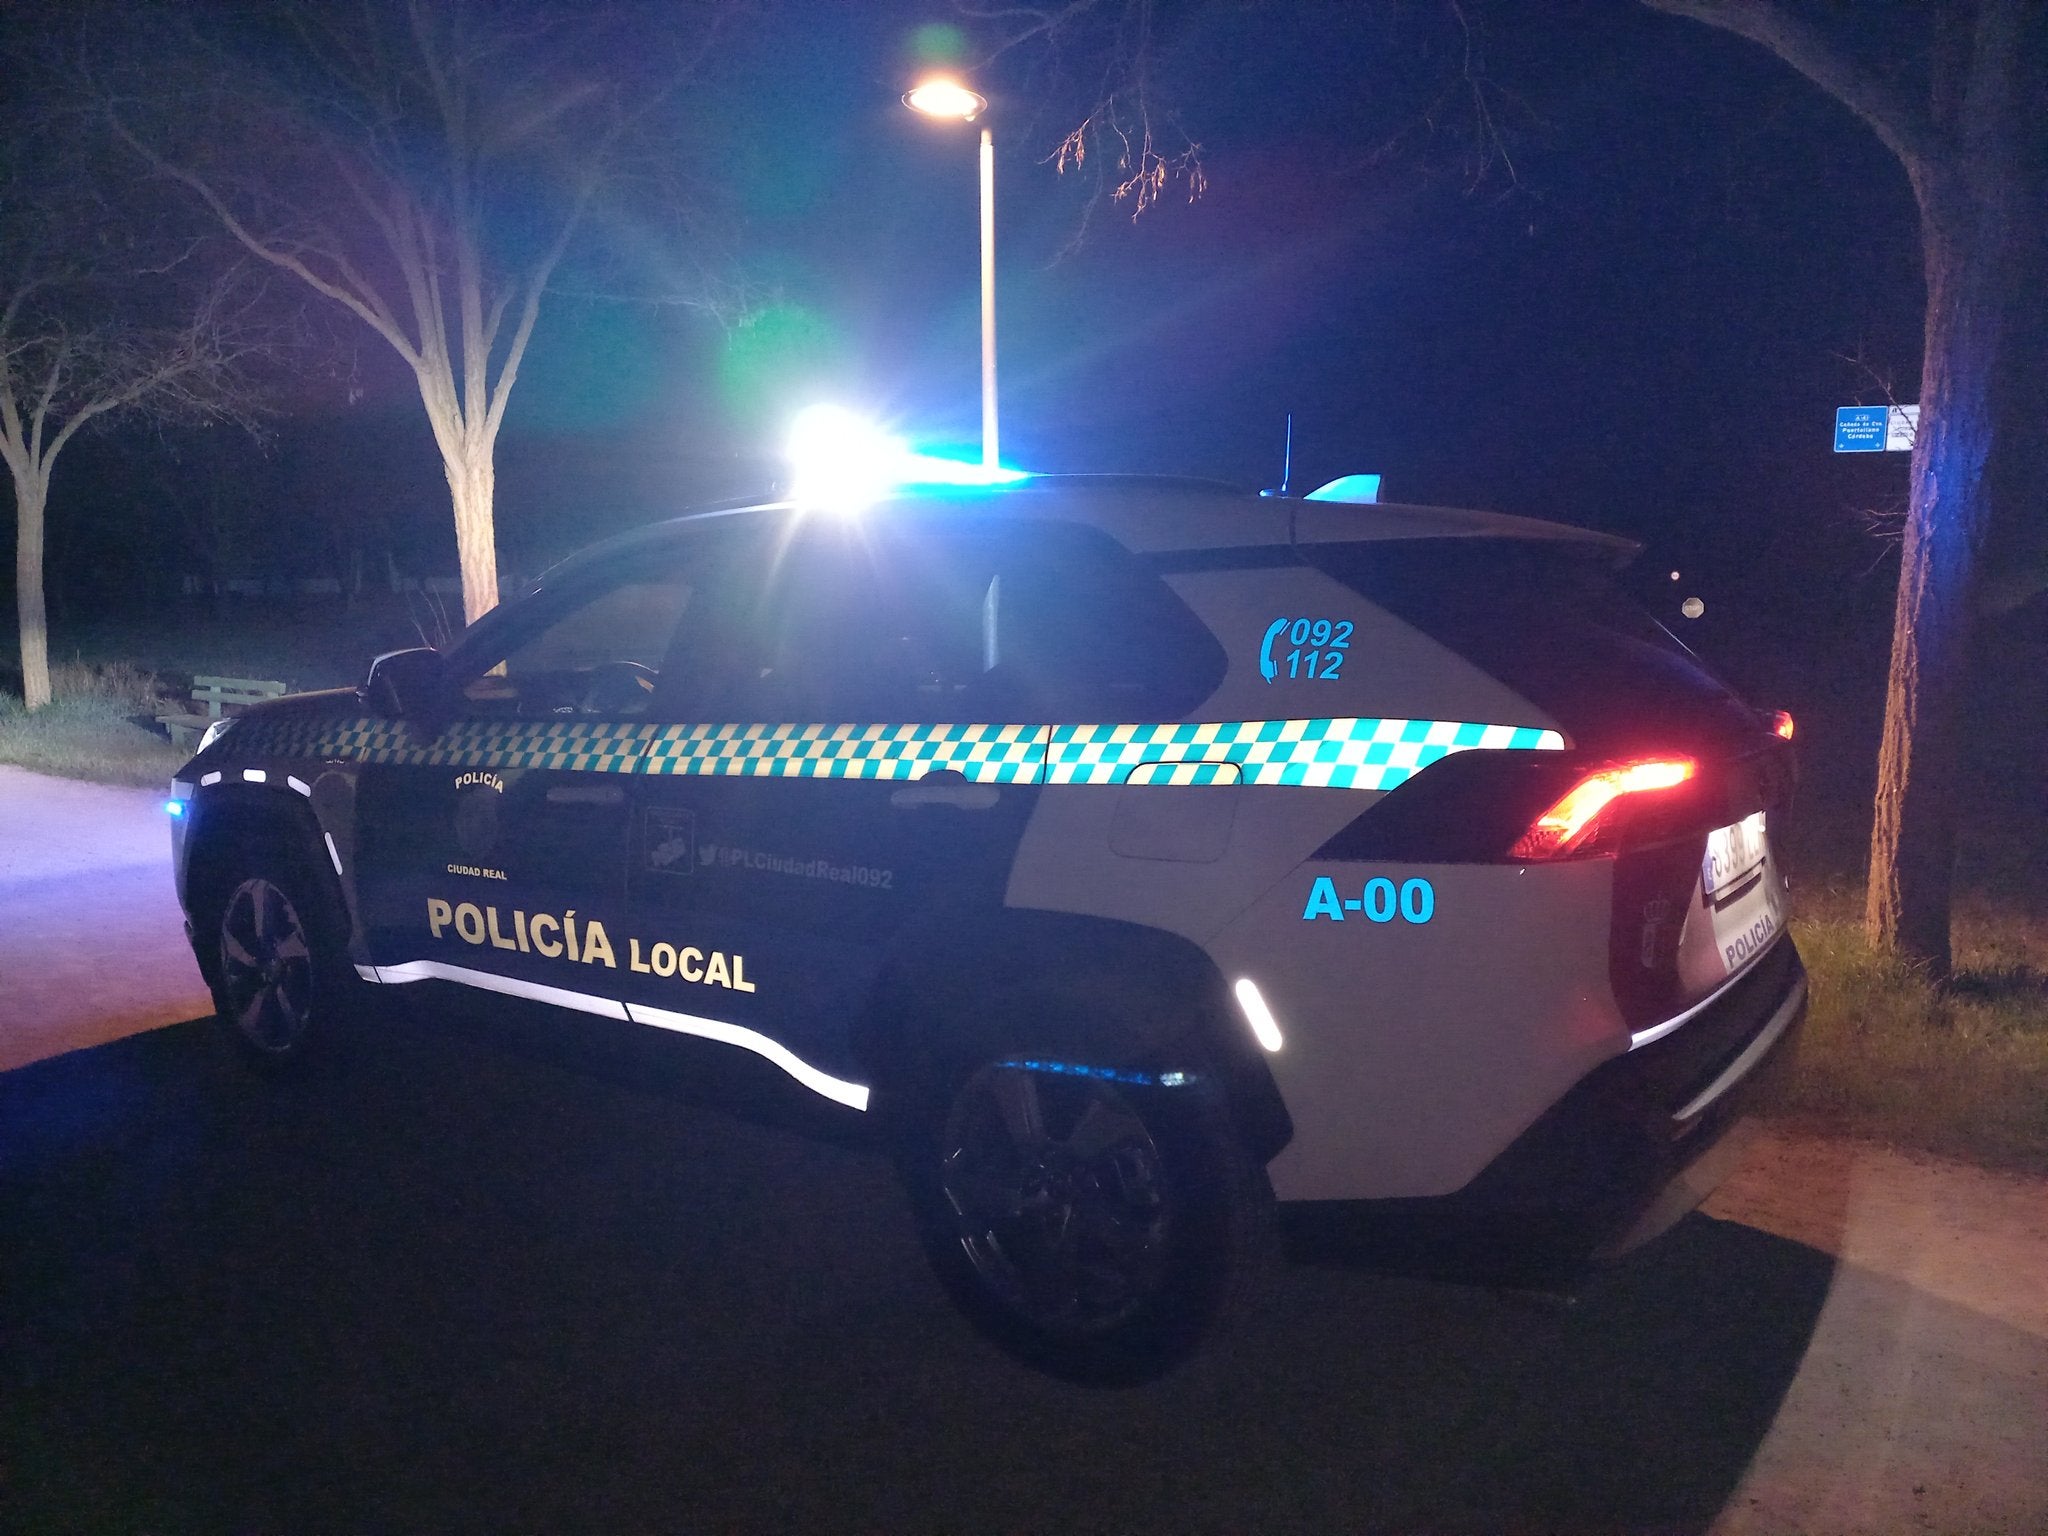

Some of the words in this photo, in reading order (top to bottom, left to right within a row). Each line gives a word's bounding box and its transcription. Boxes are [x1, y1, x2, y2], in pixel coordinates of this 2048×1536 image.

[1289, 618, 1355, 649] 092
[1285, 649, 1345, 680] 112
[455, 772, 503, 794] POLICÍA
[447, 863, 481, 877] CIUDAD
[482, 868, 508, 881] REAL
[717, 846, 894, 890] @PLCiudadReal092
[1302, 875, 1436, 926] A-00
[427, 897, 617, 969] POLICÍA
[630, 938, 756, 994] LOCAL
[1725, 914, 1776, 970] POLICÍA
